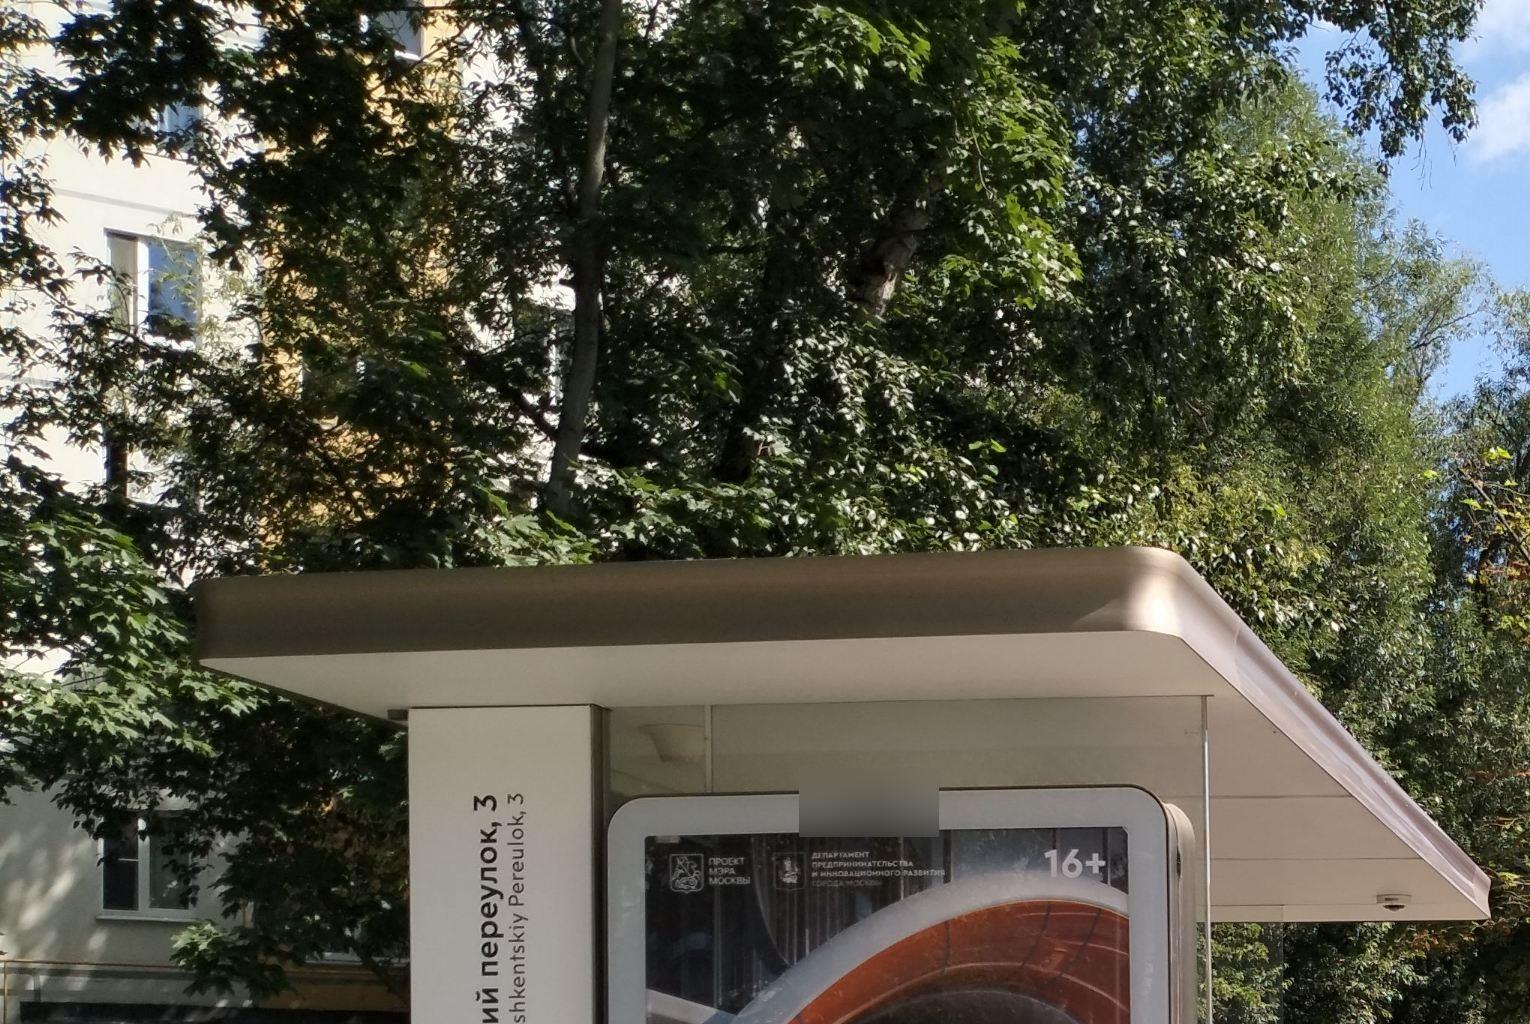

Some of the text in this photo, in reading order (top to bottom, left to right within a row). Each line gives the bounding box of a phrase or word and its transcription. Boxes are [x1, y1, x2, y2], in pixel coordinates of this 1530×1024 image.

[473, 794, 498, 812] 3
[507, 793, 524, 805] 3
[507, 811, 527, 906] Pereulok,
[811, 851, 870, 860] ДЕПАРТАМЕНТ
[708, 857, 745, 867] ПРОЕКТ
[811, 860, 914, 869] ПРЕДПРИНИМАТЕЛЬСТВА
[1043, 848, 1106, 878] 16+
[708, 866, 735, 876] МЭРА
[820, 869, 901, 878] ИННОВАЦИОННОГО
[902, 868, 946, 877] РАЗВИТИЯ
[708, 875, 751, 886] МОСКВЫ
[480, 821, 504, 977] переулок,
